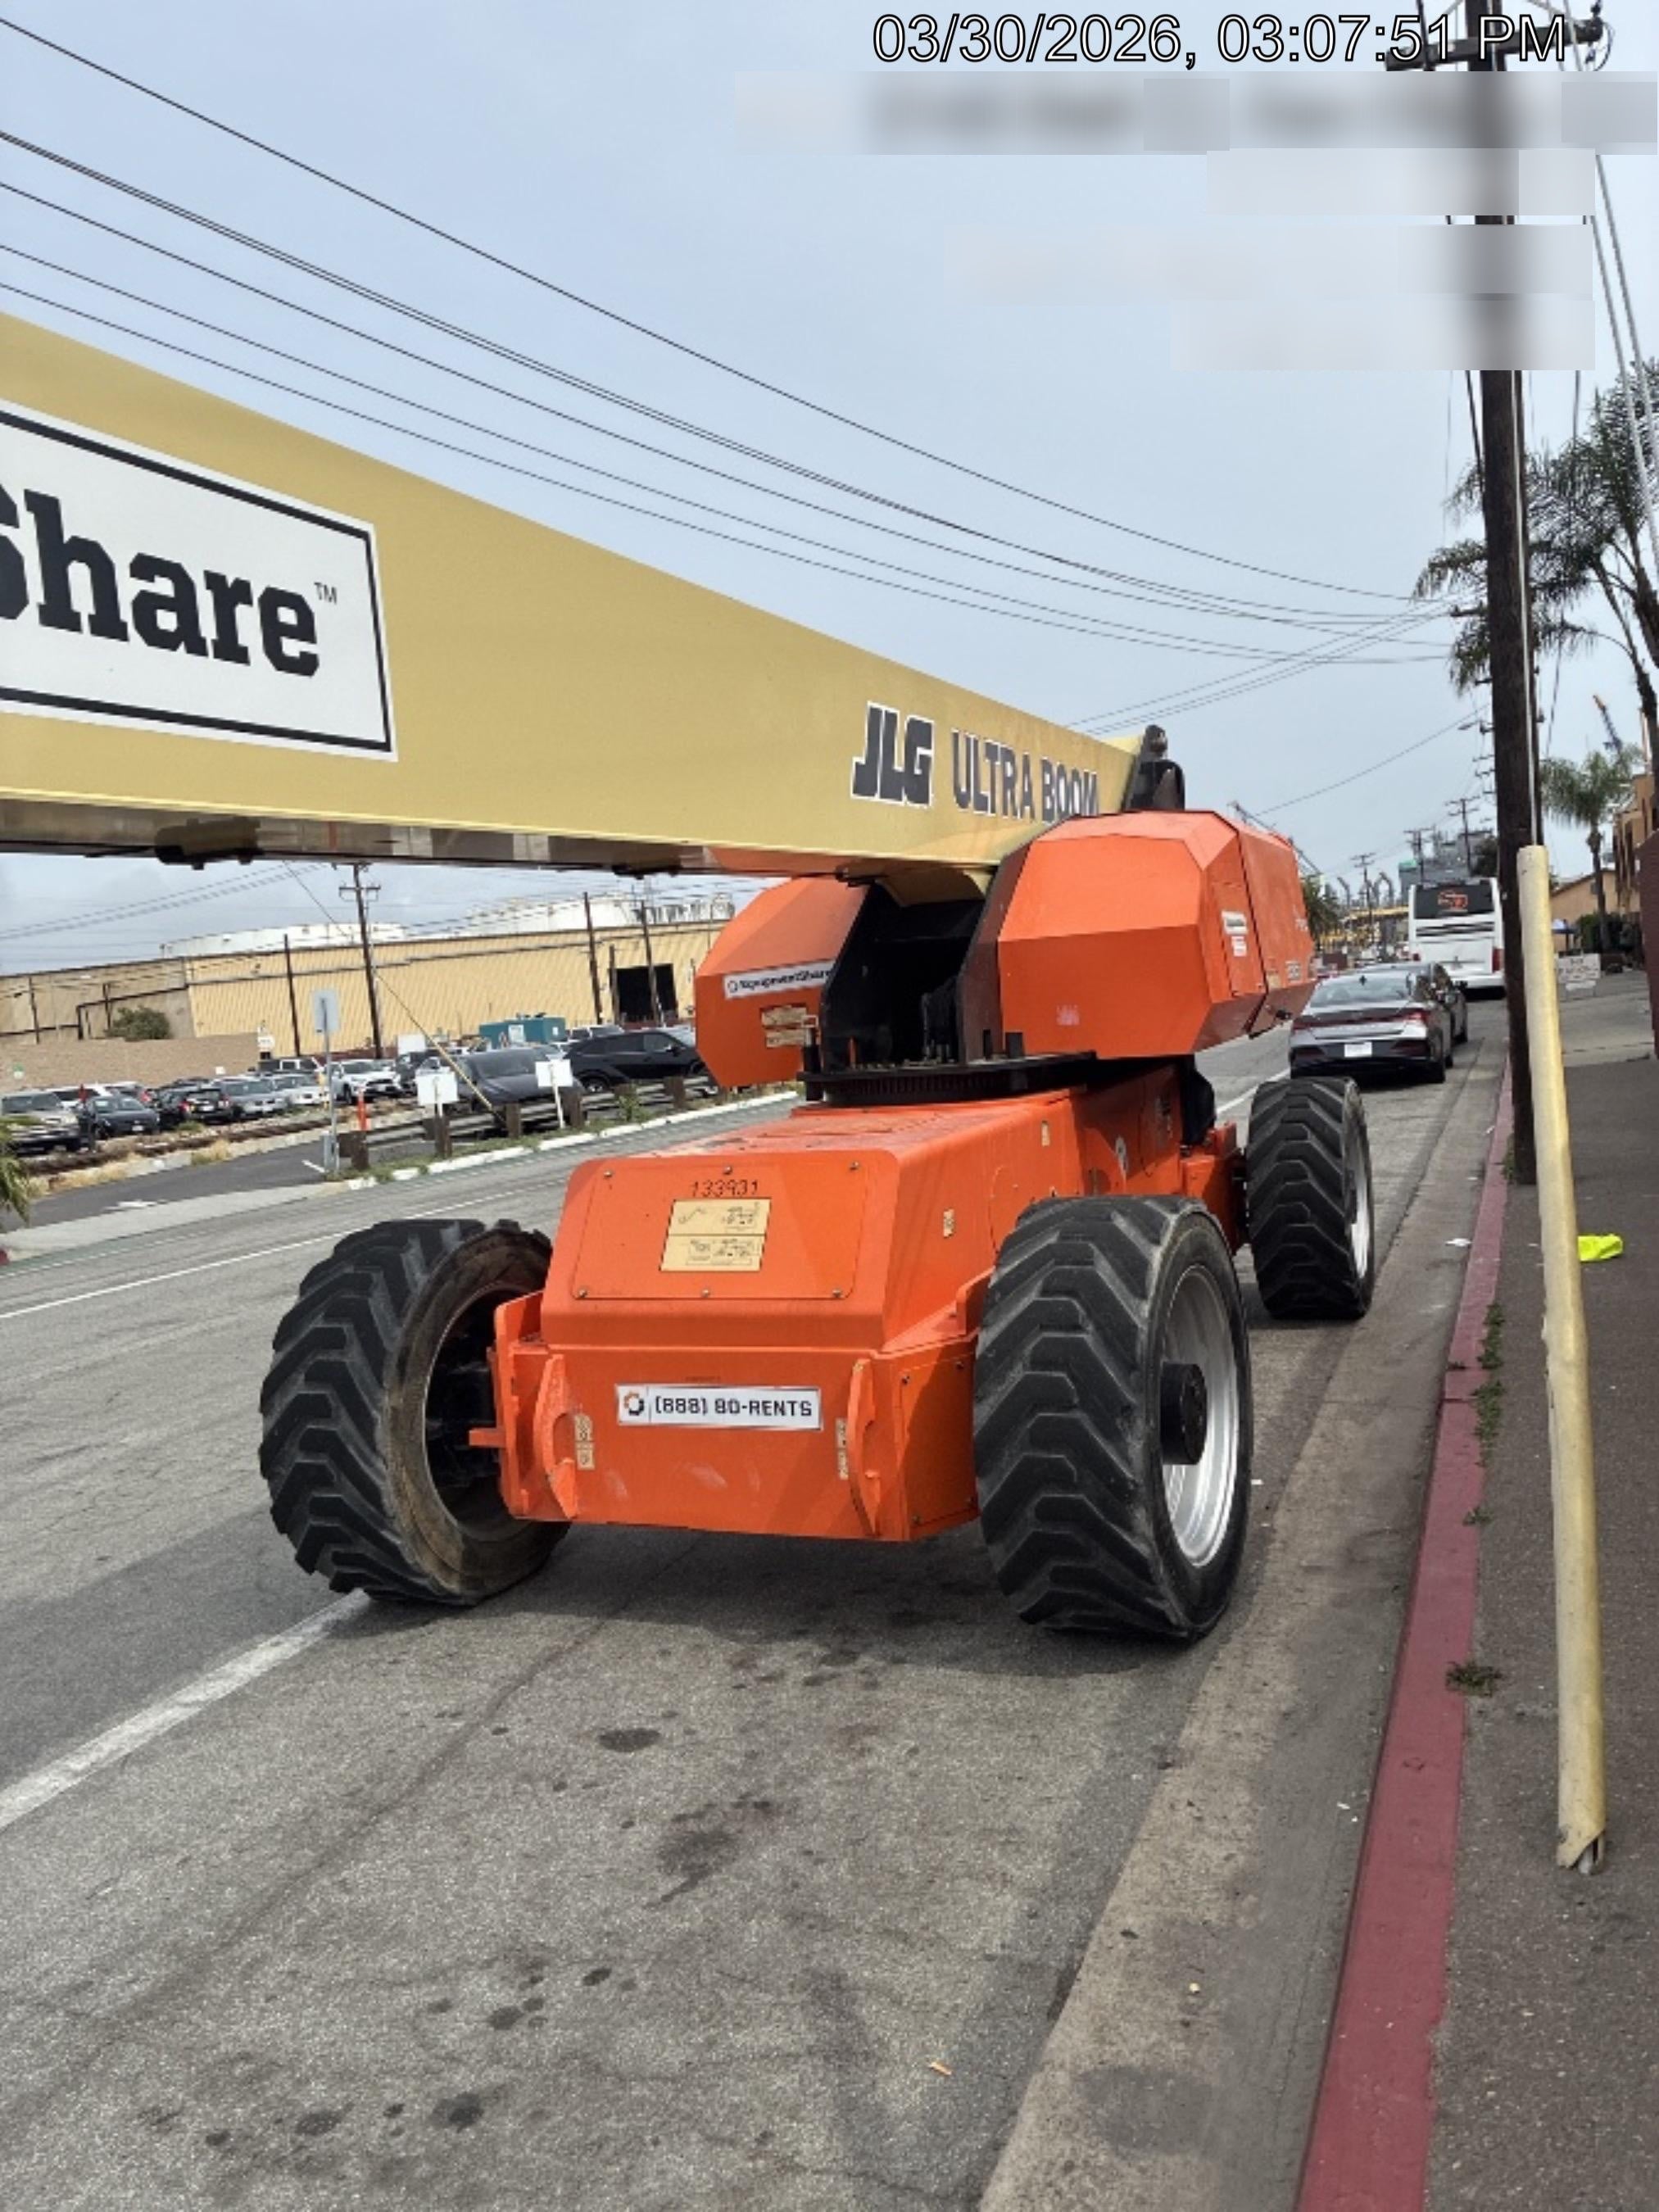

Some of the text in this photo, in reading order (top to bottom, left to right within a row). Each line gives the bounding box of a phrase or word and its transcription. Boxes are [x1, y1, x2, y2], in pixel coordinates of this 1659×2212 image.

[850, 700, 1099, 825] JLG ULTRA BOOM
[655, 1396, 812, 1416] (888) 80-RENTS
